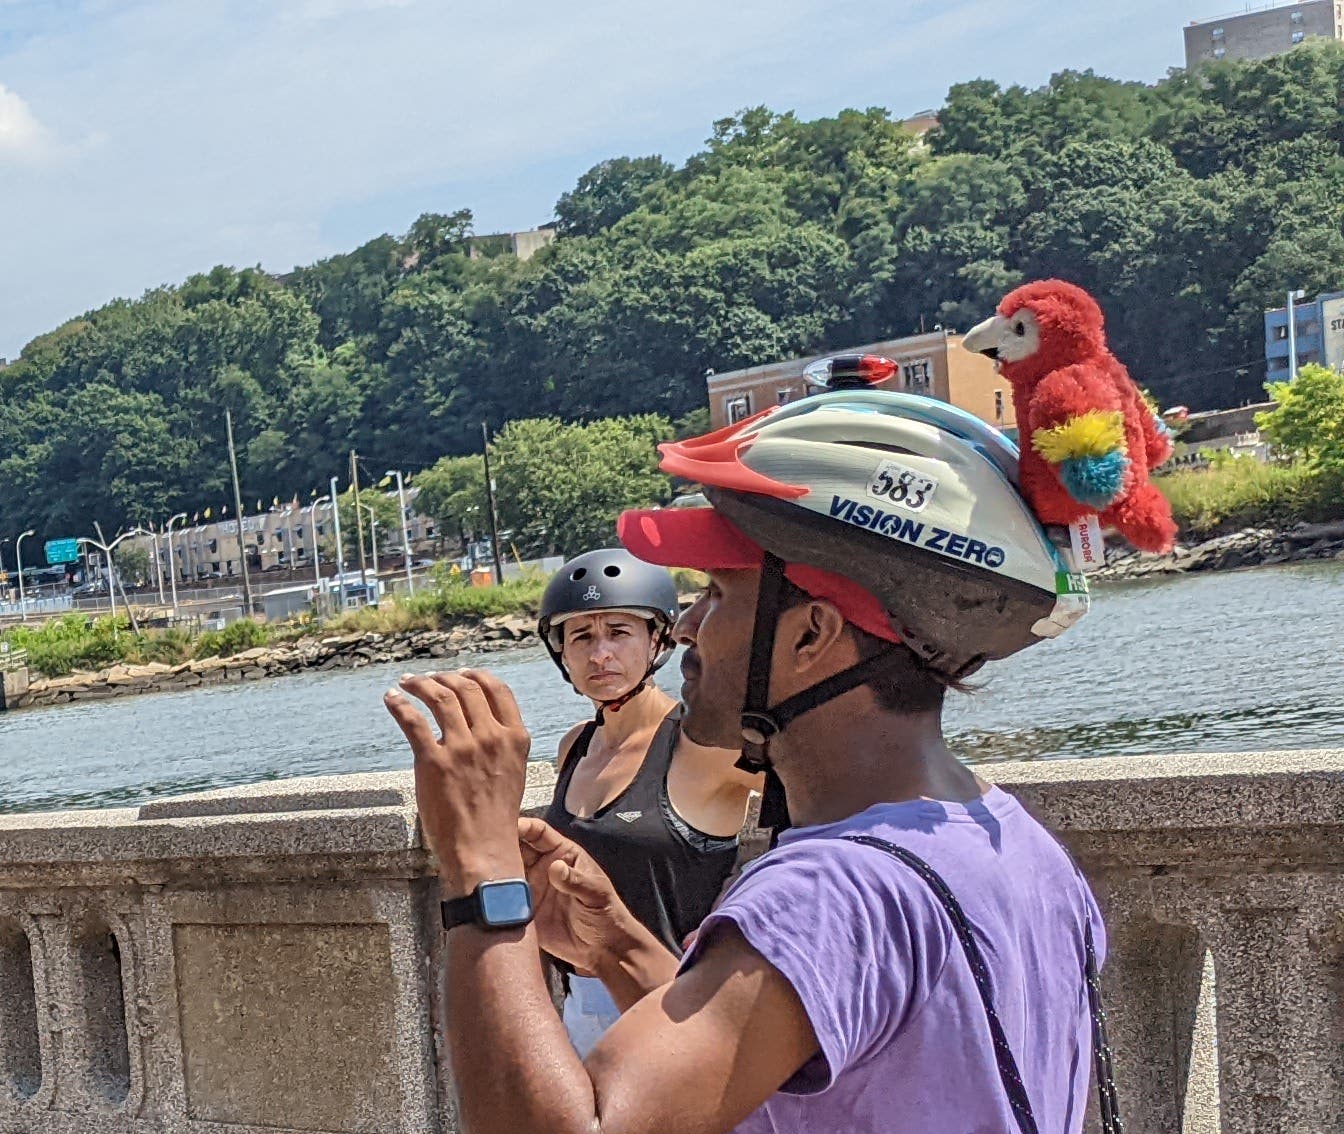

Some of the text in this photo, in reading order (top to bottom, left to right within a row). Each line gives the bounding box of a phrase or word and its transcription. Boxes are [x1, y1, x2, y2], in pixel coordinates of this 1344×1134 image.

[872, 470, 932, 508] 583
[829, 495, 1006, 567] VISION ZERO
